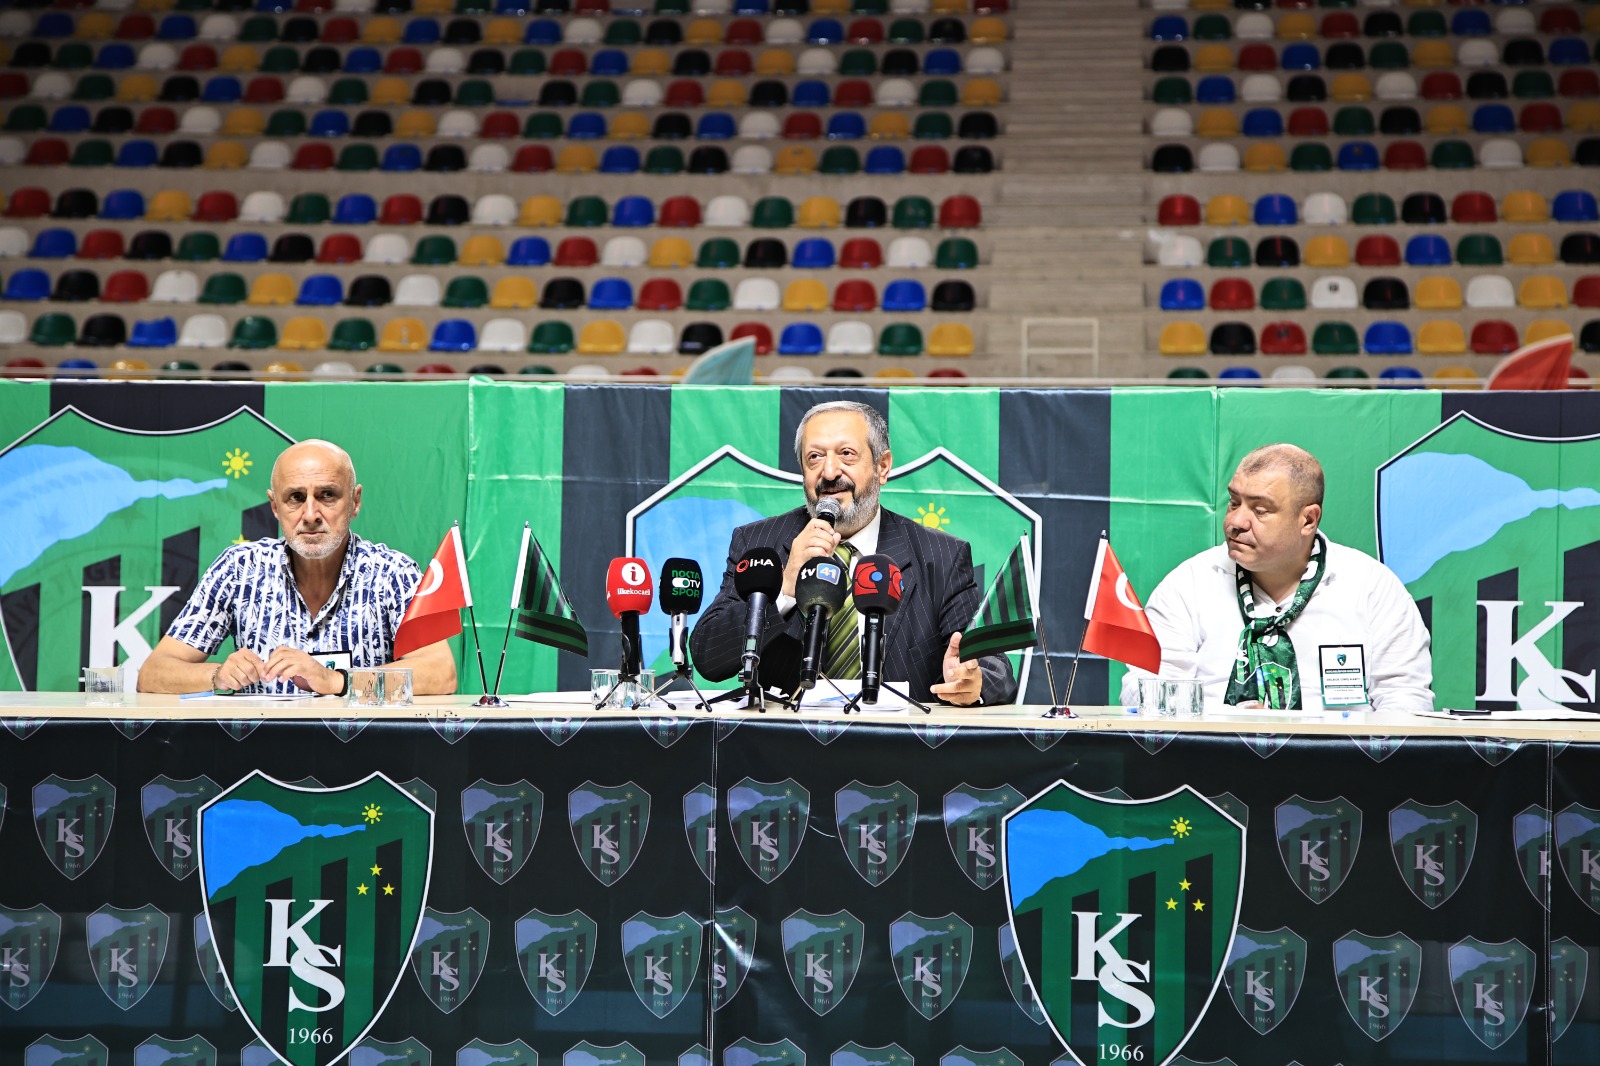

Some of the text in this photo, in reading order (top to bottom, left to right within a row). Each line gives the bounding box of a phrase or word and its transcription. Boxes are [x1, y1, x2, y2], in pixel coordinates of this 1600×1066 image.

[672, 588, 700, 598] SPOR
[820, 567, 836, 579] 41
[57, 818, 85, 858] KS
[165, 818, 193, 858] KS
[485, 823, 513, 863] KS
[592, 825, 620, 865] KS
[751, 822, 779, 861] KS
[860, 825, 887, 864] KS
[968, 827, 996, 868] KS
[1300, 841, 1330, 882] KS
[1414, 845, 1445, 886] KS
[2, 947, 30, 987] KS
[111, 947, 138, 988] KS
[263, 899, 346, 1012] KS
[432, 952, 460, 991] KS
[538, 953, 566, 993] KS
[805, 953, 833, 993] KS
[1071, 912, 1155, 1028] KS
[644, 956, 673, 996] KS
[914, 957, 942, 998] KS
[1246, 971, 1275, 1012] KS
[1360, 976, 1389, 1018] KS
[1475, 983, 1506, 1026] KS
[288, 1028, 333, 1045] 1966
[1099, 1044, 1144, 1061] 1966
